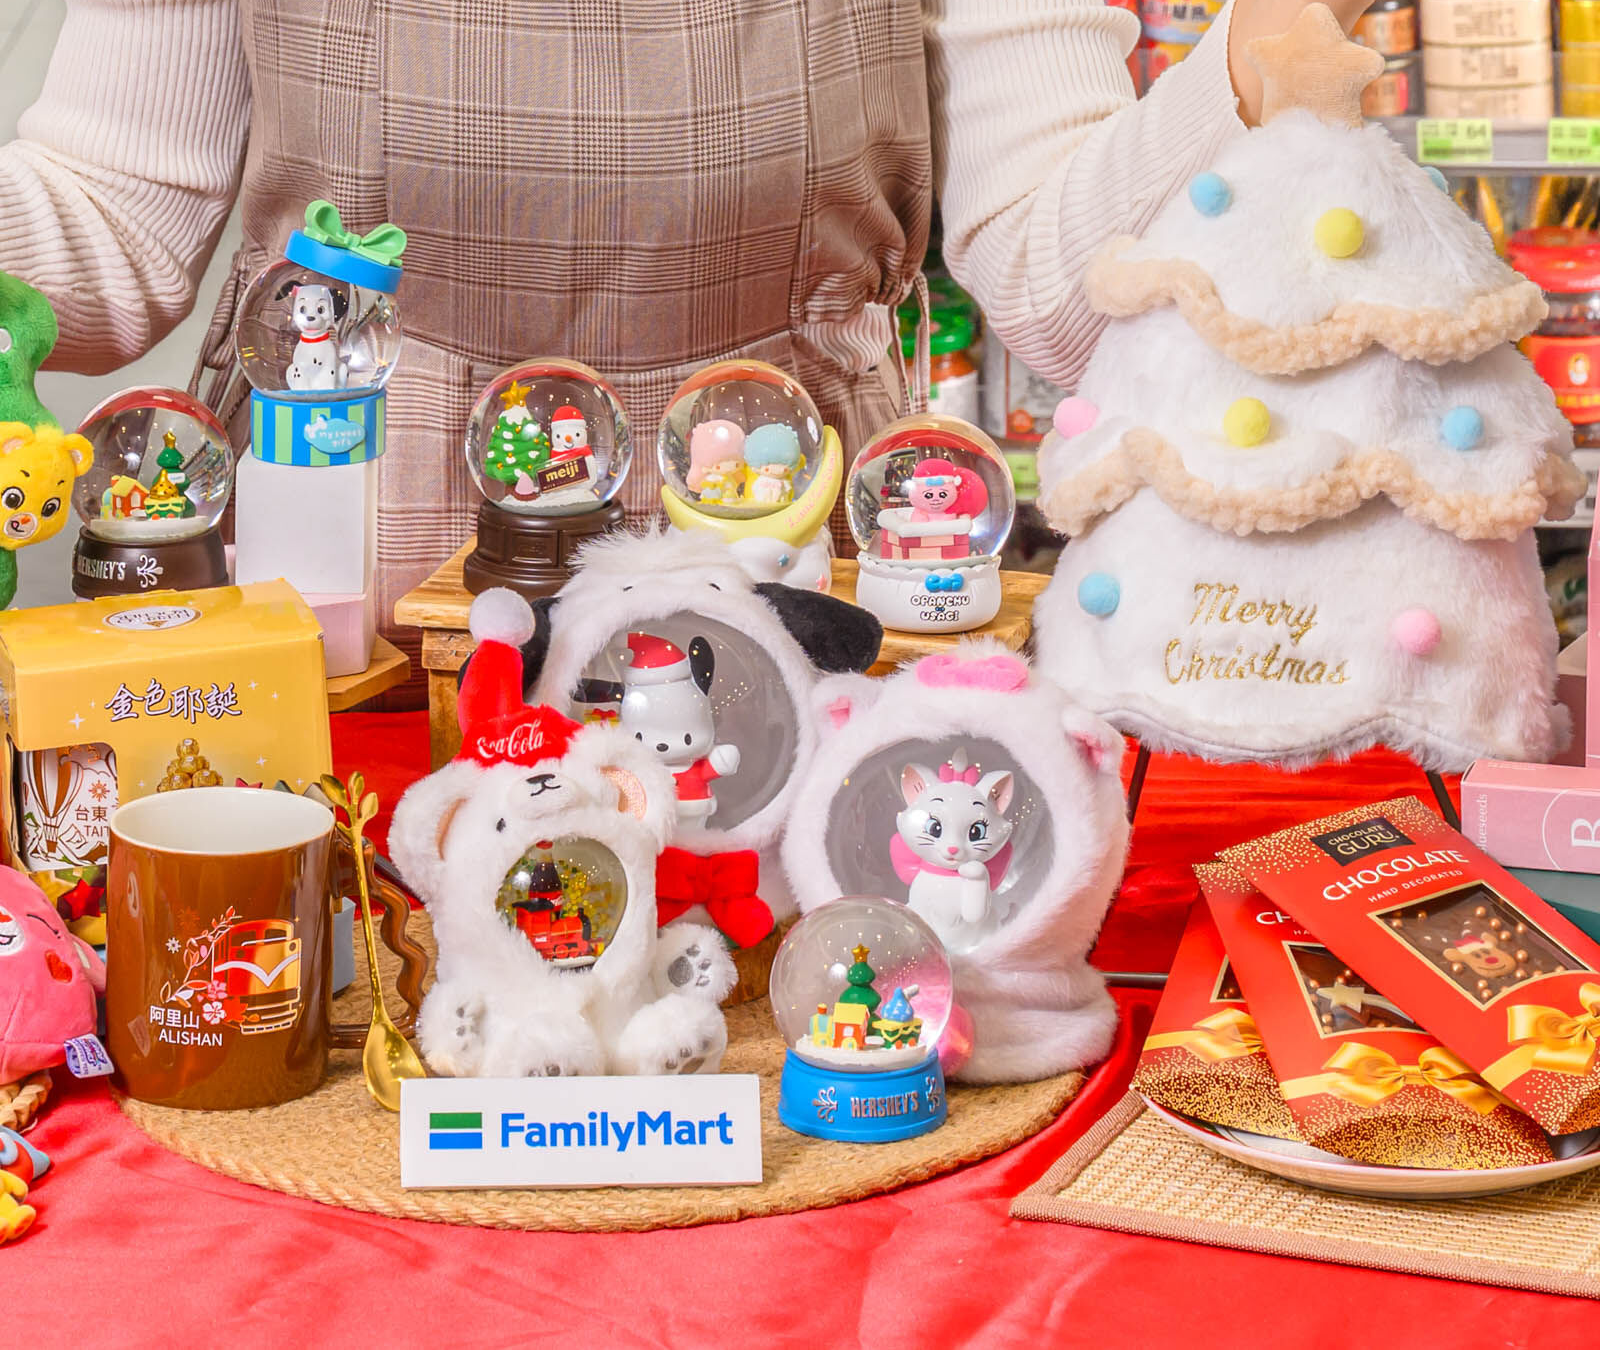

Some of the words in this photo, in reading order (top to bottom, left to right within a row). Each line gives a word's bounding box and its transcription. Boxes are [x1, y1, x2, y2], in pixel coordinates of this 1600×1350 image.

[545, 457, 580, 484] meiji
[911, 595, 970, 606] OPANCHU
[1189, 582, 1317, 646] Merry
[920, 611, 959, 622] USAGI
[1164, 638, 1351, 685] Christmas
[104, 677, 243, 724] 金色耶誕
[75, 804, 108, 822] 台東
[1476, 794, 1488, 851] lueseeds
[84, 824, 110, 838] TAIT
[1328, 824, 1385, 846] CHOCOLATE
[1323, 850, 1470, 901] CHOCOLATE
[1367, 886, 1399, 903] HAND
[1403, 869, 1464, 890] DECORATED
[150, 1005, 200, 1029] 阿里山
[158, 1028, 223, 1047] ALISHAN
[849, 1088, 919, 1119] HERSHEY'S
[500, 1109, 734, 1152] FamilyMart
